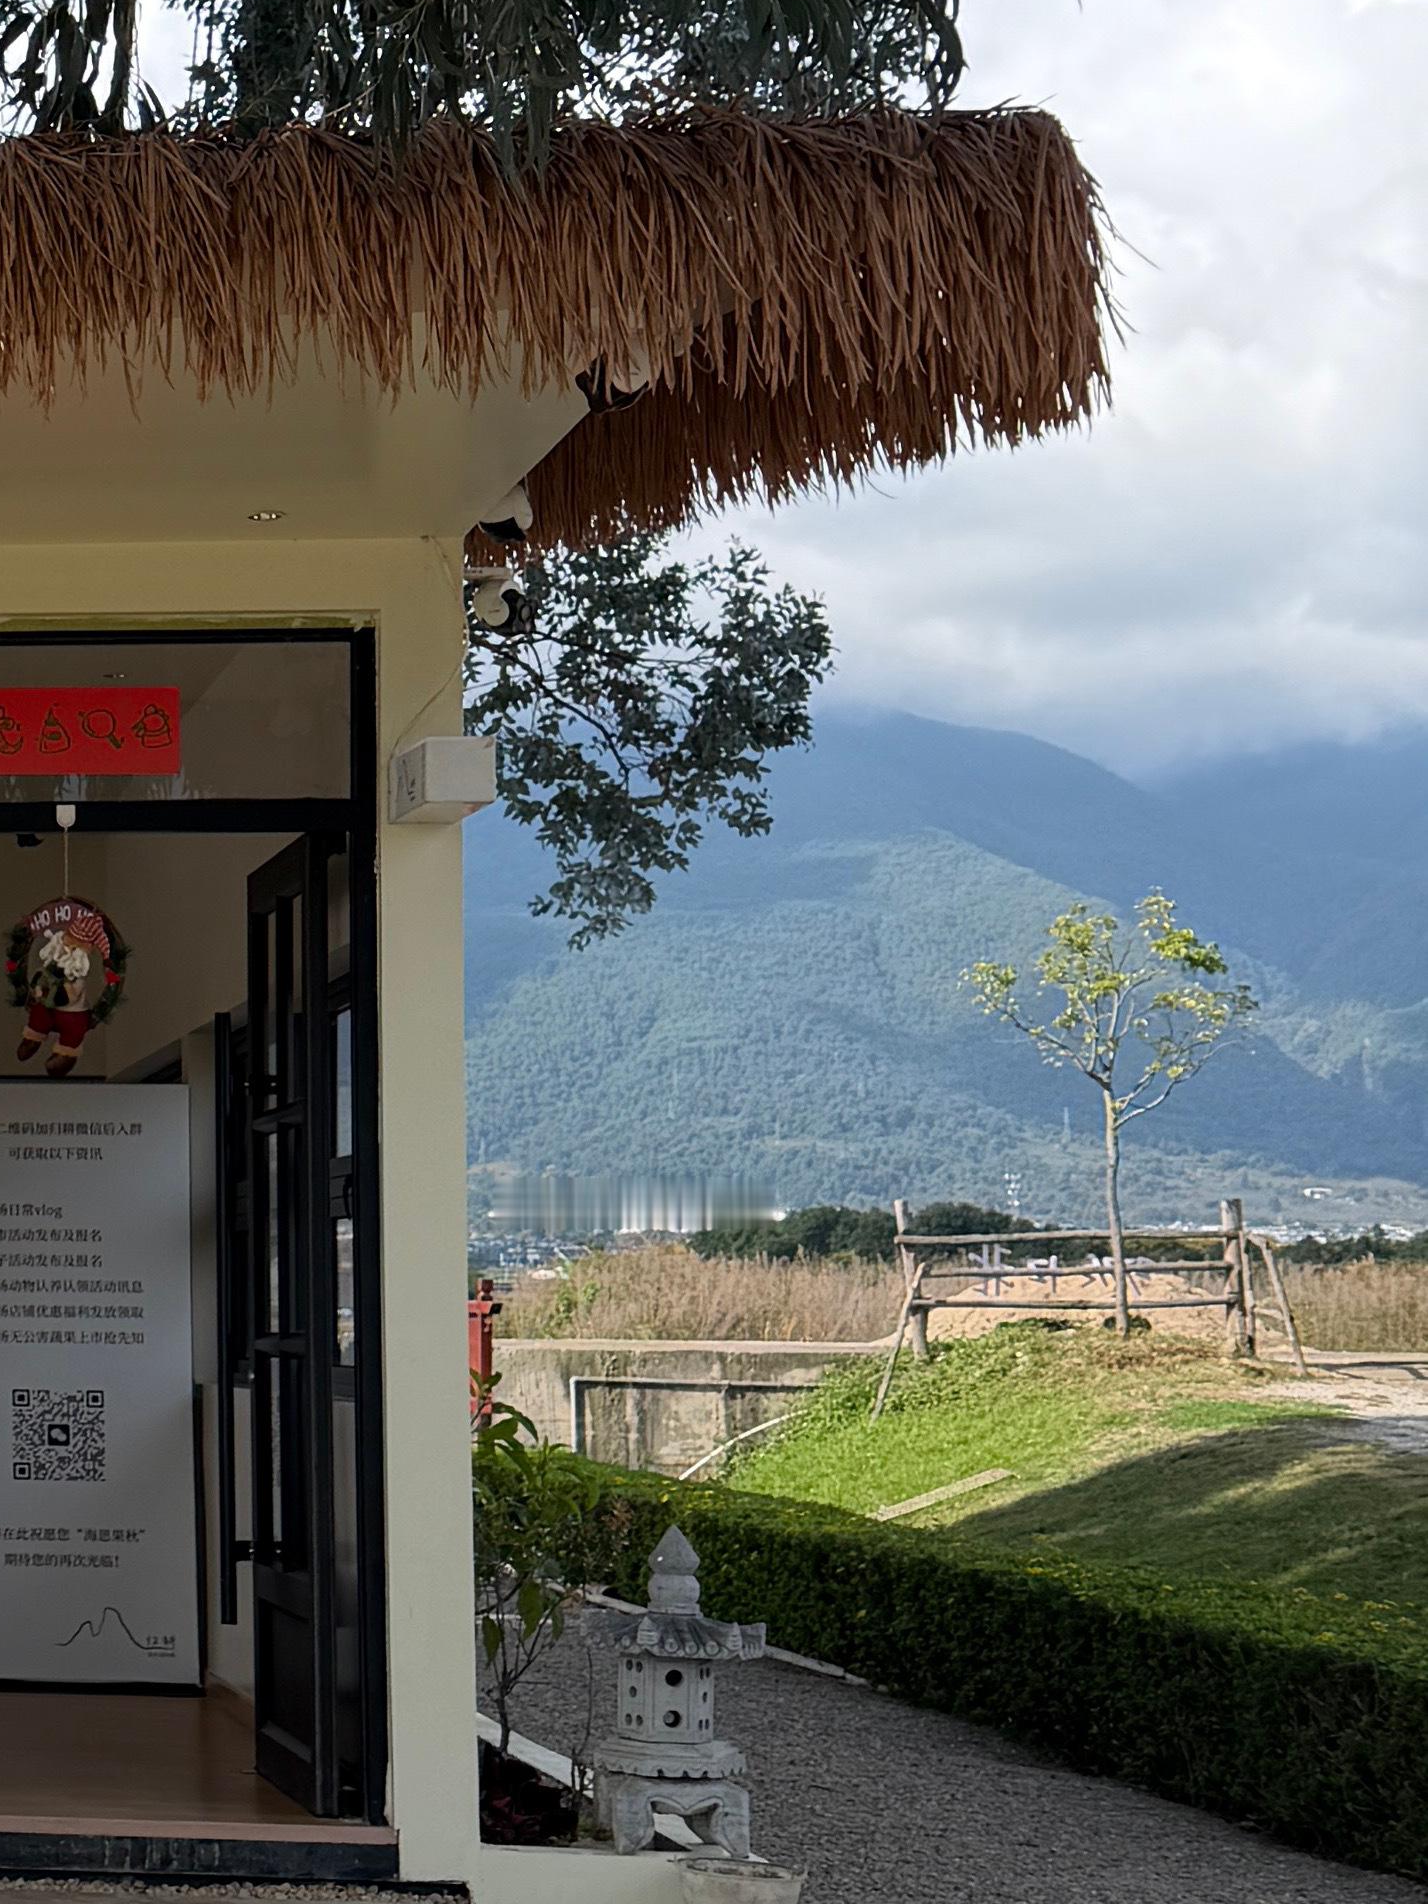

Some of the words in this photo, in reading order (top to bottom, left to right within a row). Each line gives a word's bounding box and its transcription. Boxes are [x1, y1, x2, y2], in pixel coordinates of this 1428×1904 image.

[54, 905, 72, 923] HO
[8, 1146, 104, 1162] 可获取以下资讯
